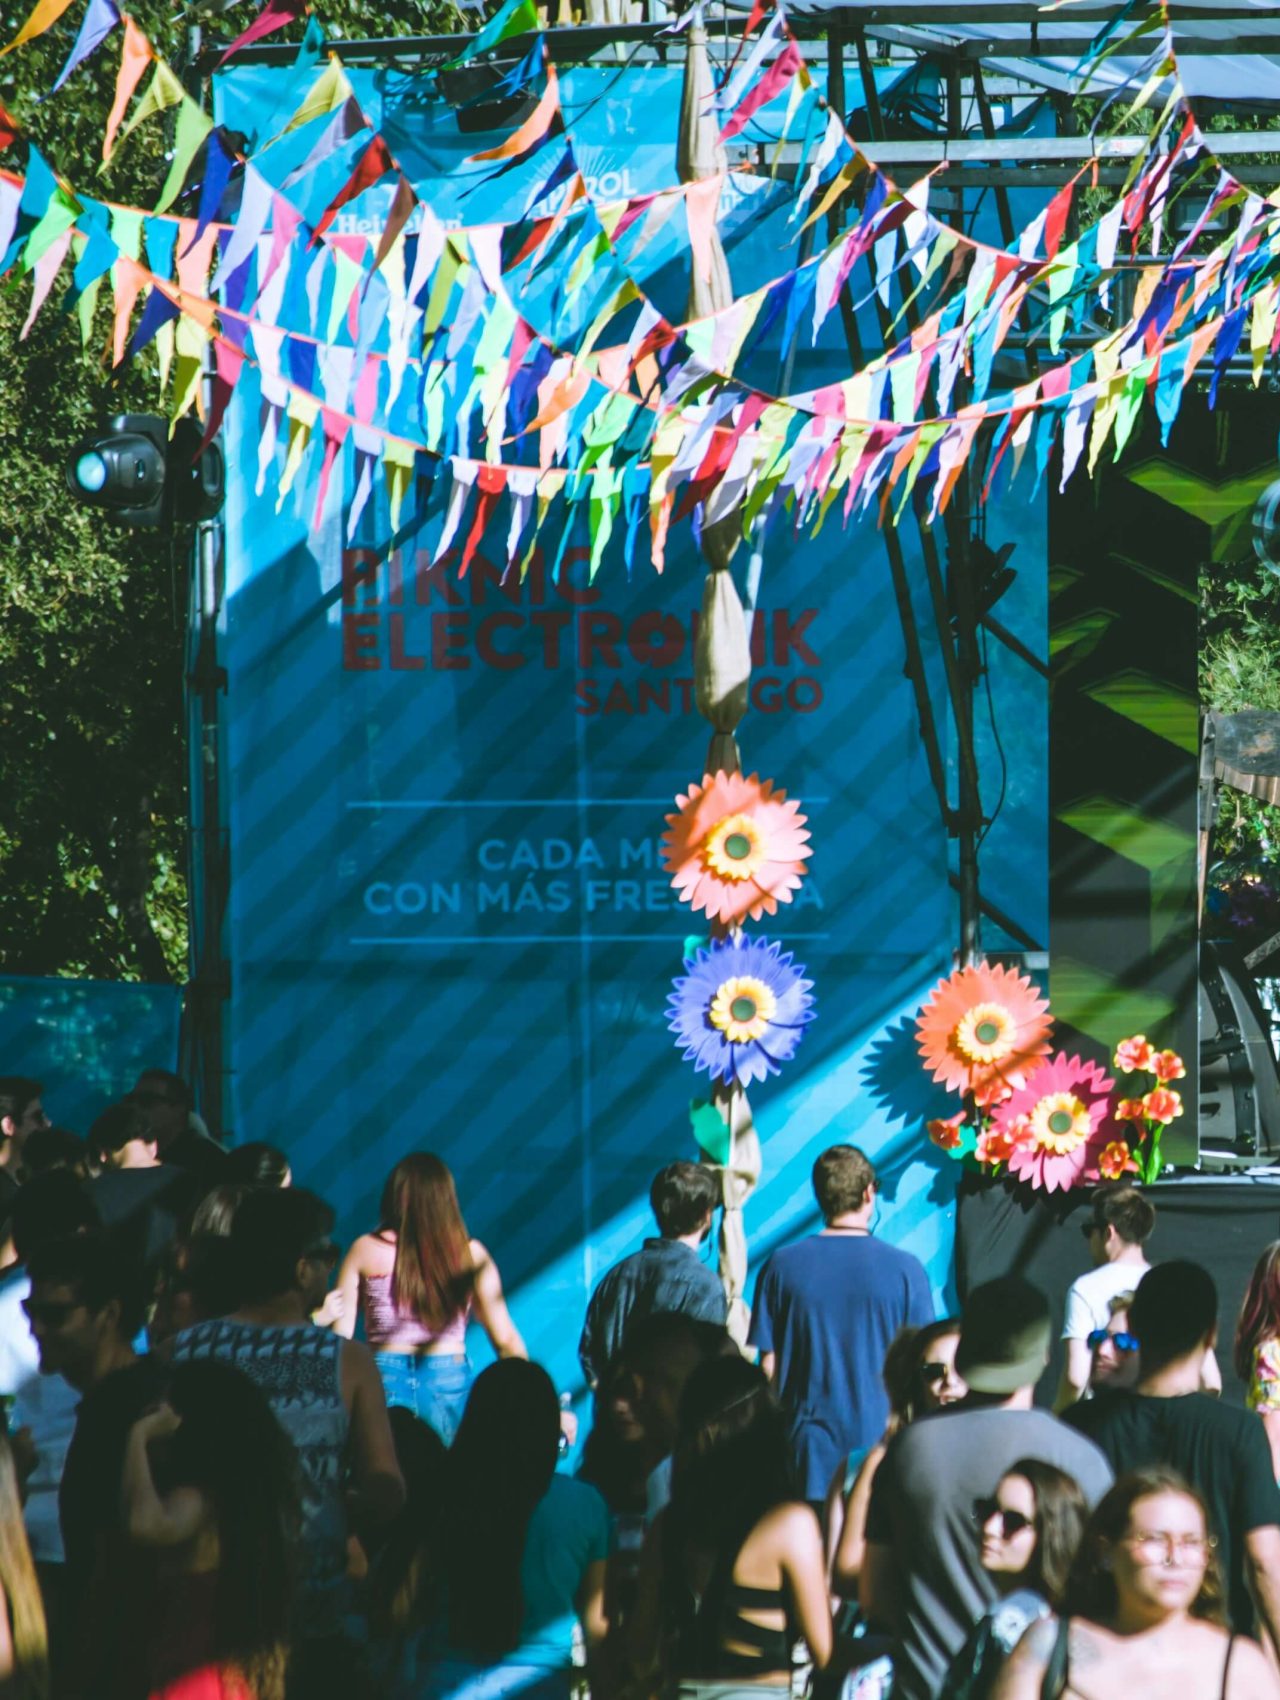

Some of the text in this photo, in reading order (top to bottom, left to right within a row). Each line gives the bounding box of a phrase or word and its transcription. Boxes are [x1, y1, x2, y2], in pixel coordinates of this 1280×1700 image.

[338, 213, 463, 234] Heien
[341, 547, 602, 606] PIKNIC
[342, 609, 822, 671] ELECTROIK
[576, 676, 824, 716] SANTGO
[478, 838, 605, 871] CADA
[363, 881, 460, 914] CON
[478, 872, 570, 912] MÁS
